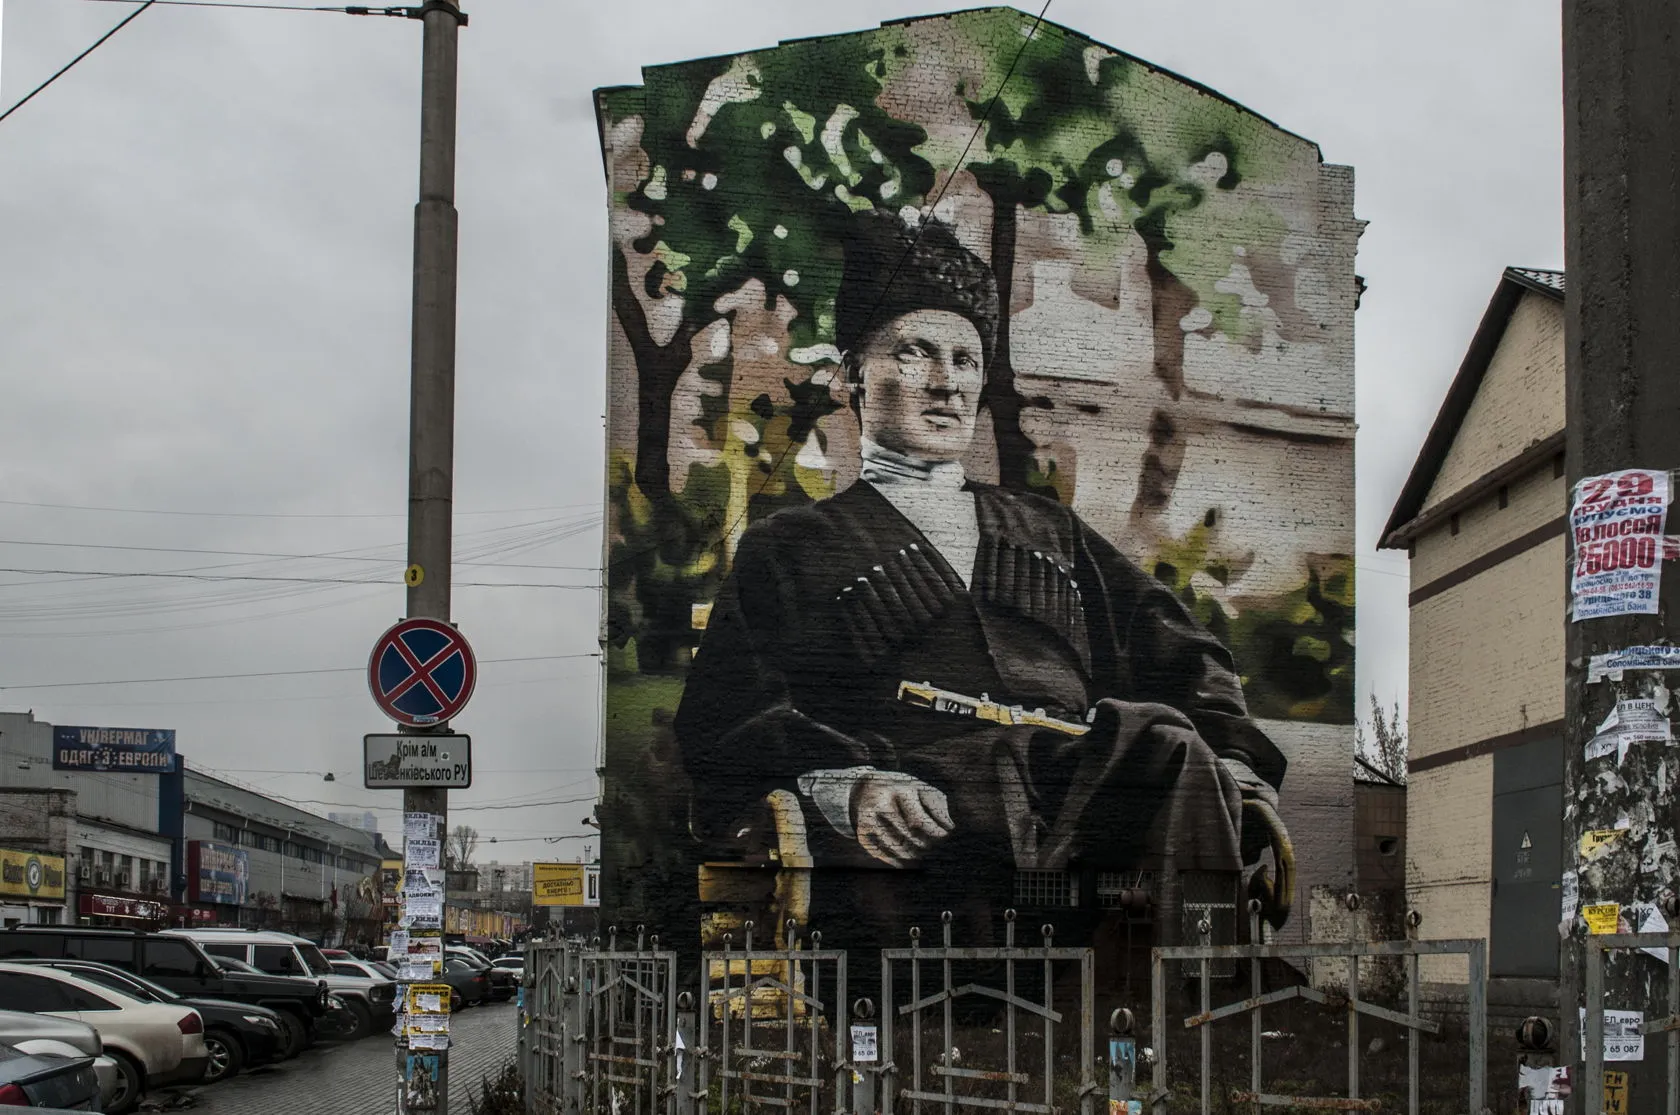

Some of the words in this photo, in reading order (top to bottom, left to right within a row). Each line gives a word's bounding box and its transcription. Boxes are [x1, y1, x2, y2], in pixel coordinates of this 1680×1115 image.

[1582, 473, 1653, 504] 29
[1577, 537, 1655, 578] 25000
[1638, 590, 1652, 599] 38
[61, 750, 94, 766] ОДЯГ
[397, 740, 418, 760] Крім
[368, 763, 451, 781] Шевенківського
[454, 764, 467, 781] РУ
[1610, 1045, 1621, 1053] 65
[1624, 1045, 1640, 1053] 087
